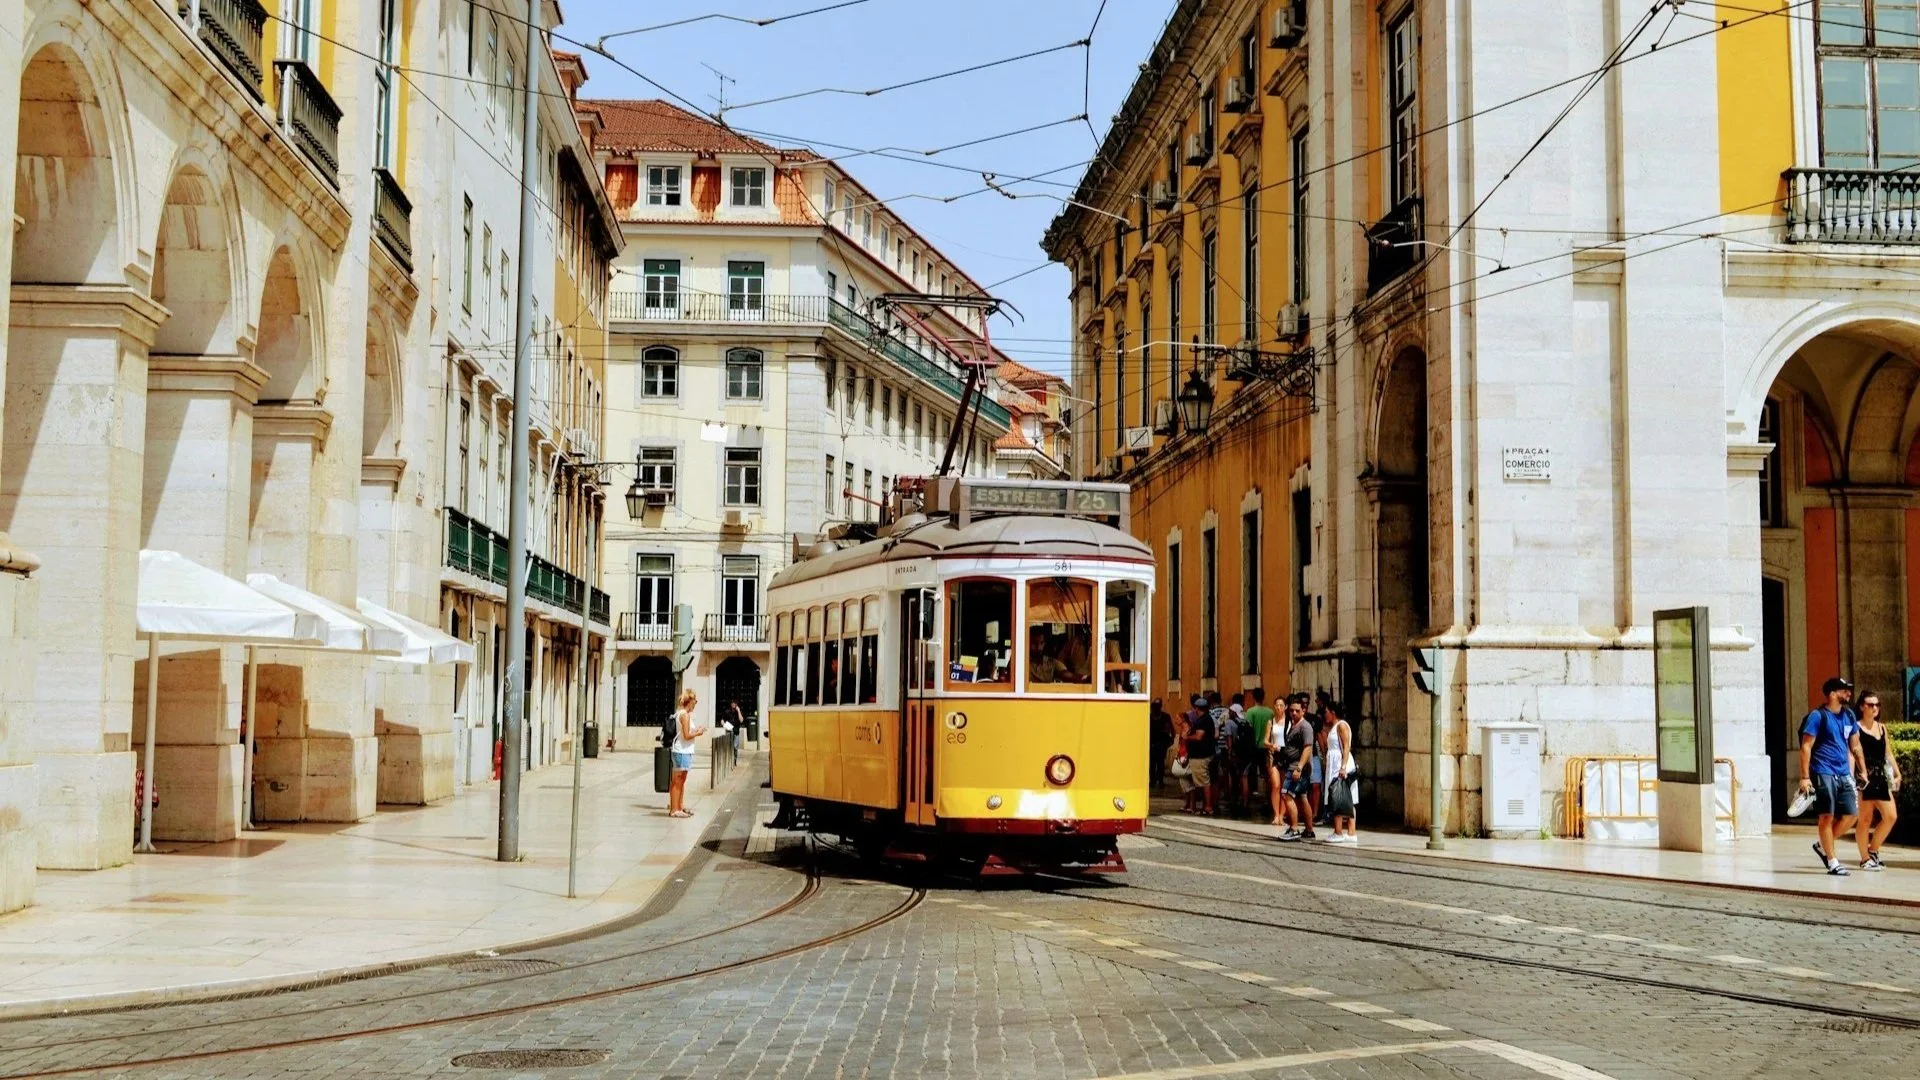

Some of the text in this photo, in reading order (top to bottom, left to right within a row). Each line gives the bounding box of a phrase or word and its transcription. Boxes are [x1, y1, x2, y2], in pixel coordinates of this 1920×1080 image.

[1511, 448, 1544, 456] PRAÇA
[1505, 460, 1550, 468] COMERCIO
[976, 488, 1106, 510] ESTRELA 25
[895, 566, 917, 575] ENTRADA
[1054, 562, 1072, 571] 581
